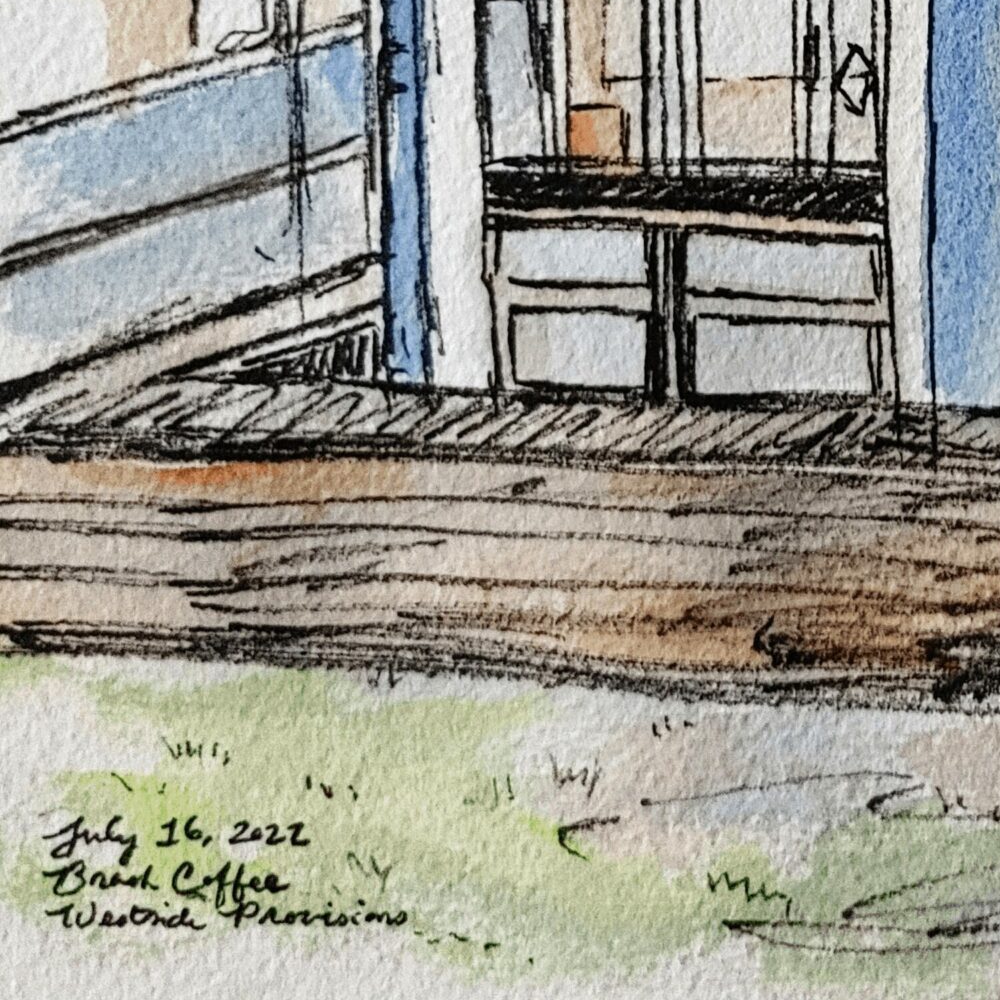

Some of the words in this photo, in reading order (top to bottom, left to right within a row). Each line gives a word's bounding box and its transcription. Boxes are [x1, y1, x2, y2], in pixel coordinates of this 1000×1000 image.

[43, 815, 137, 866] July
[156, 816, 213, 847] 16,
[228, 819, 311, 847] 2022
[43, 860, 159, 896] Brash
[171, 861, 291, 906] Coffee
[46, 901, 206, 930] Westside
[218, 900, 409, 928] Provisions
